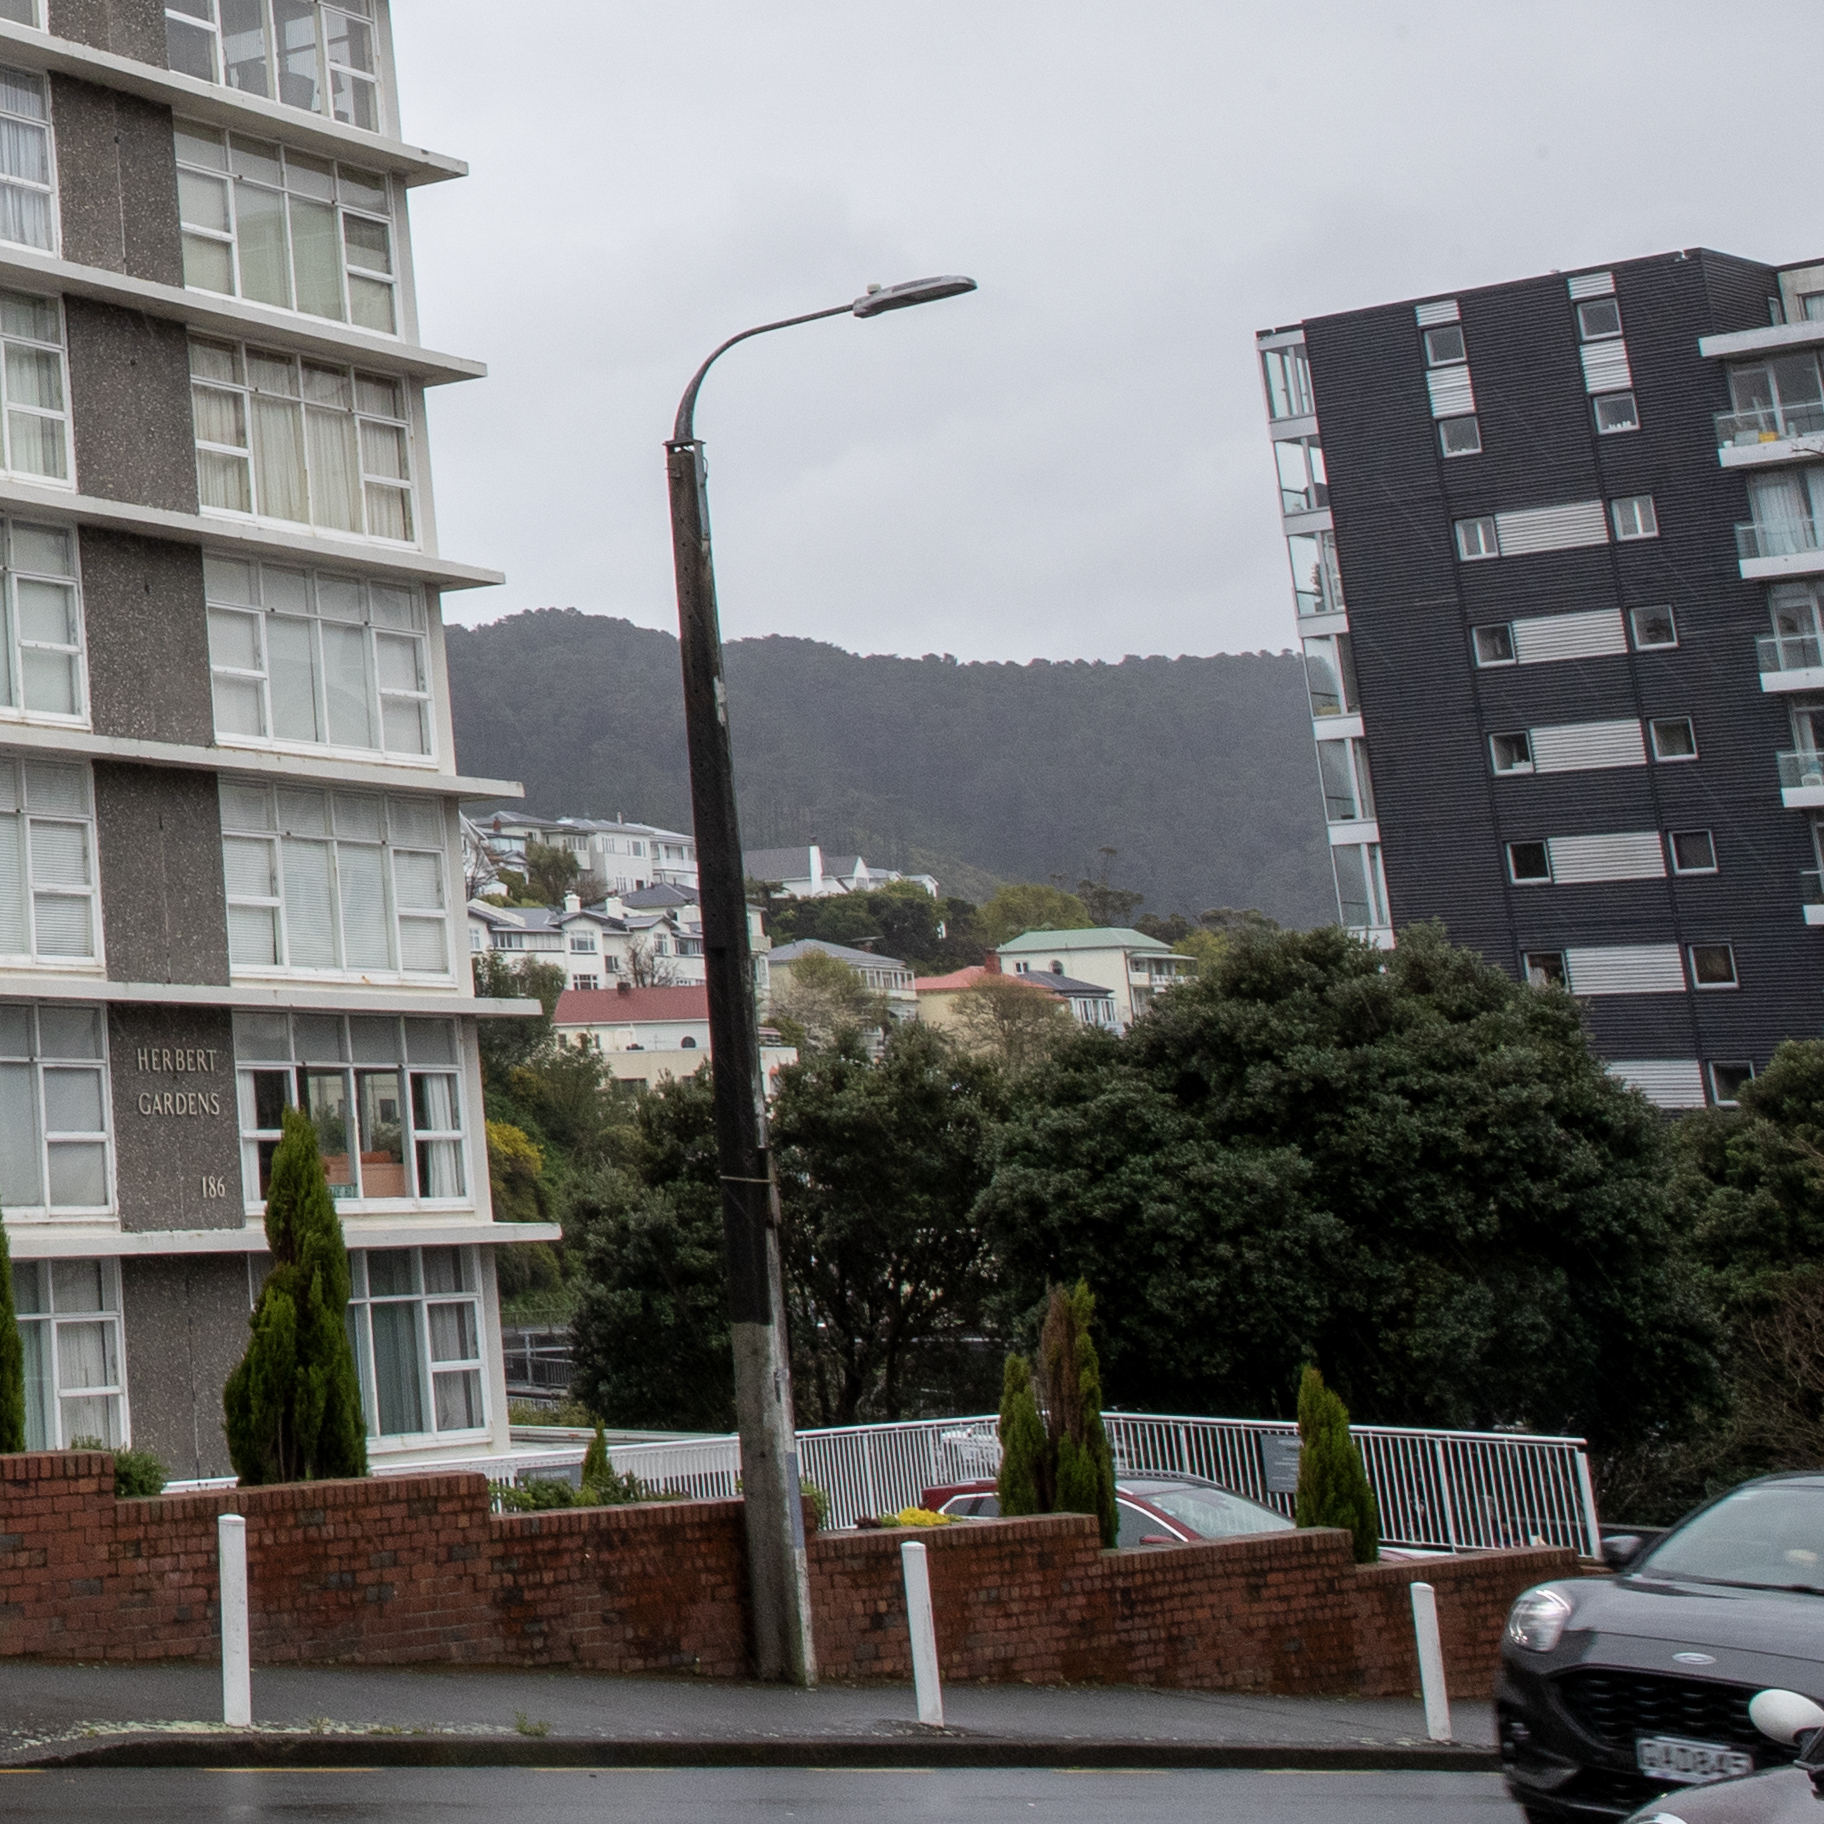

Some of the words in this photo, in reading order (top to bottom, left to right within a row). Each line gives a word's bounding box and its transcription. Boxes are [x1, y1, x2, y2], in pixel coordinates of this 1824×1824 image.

[137, 1048, 217, 1072] HERBERT
[138, 1092, 220, 1116] GARDENS
[202, 1176, 226, 1198] 186
